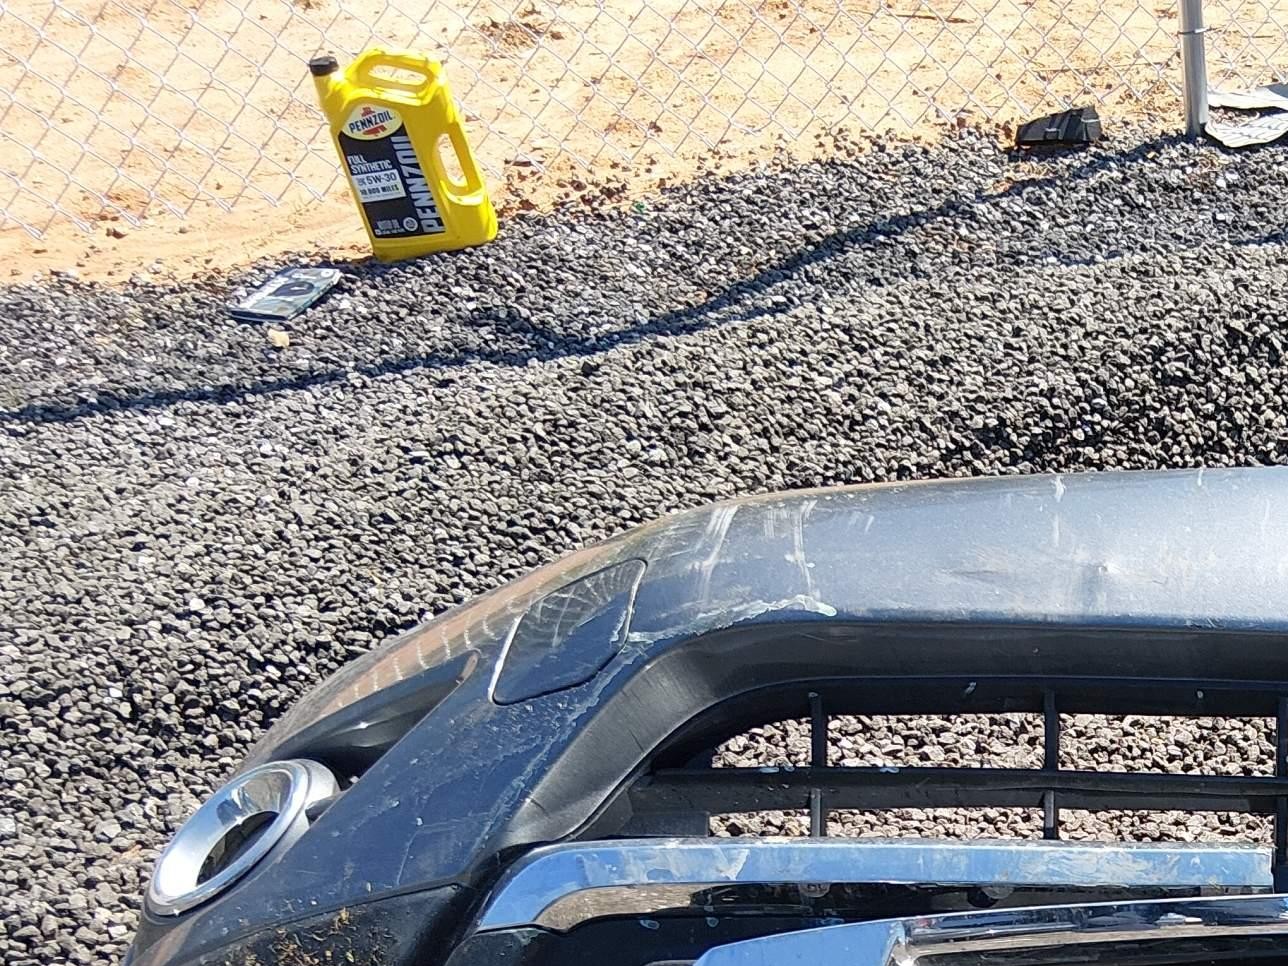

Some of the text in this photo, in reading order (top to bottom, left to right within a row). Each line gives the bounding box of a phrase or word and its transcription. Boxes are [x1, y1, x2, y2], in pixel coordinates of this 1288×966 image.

[349, 111, 393, 134] PENNZOIL
[351, 160, 392, 174] SYNTHETIC
[366, 172, 397, 185] 5W-30
[391, 136, 445, 232] PENNZOIL
